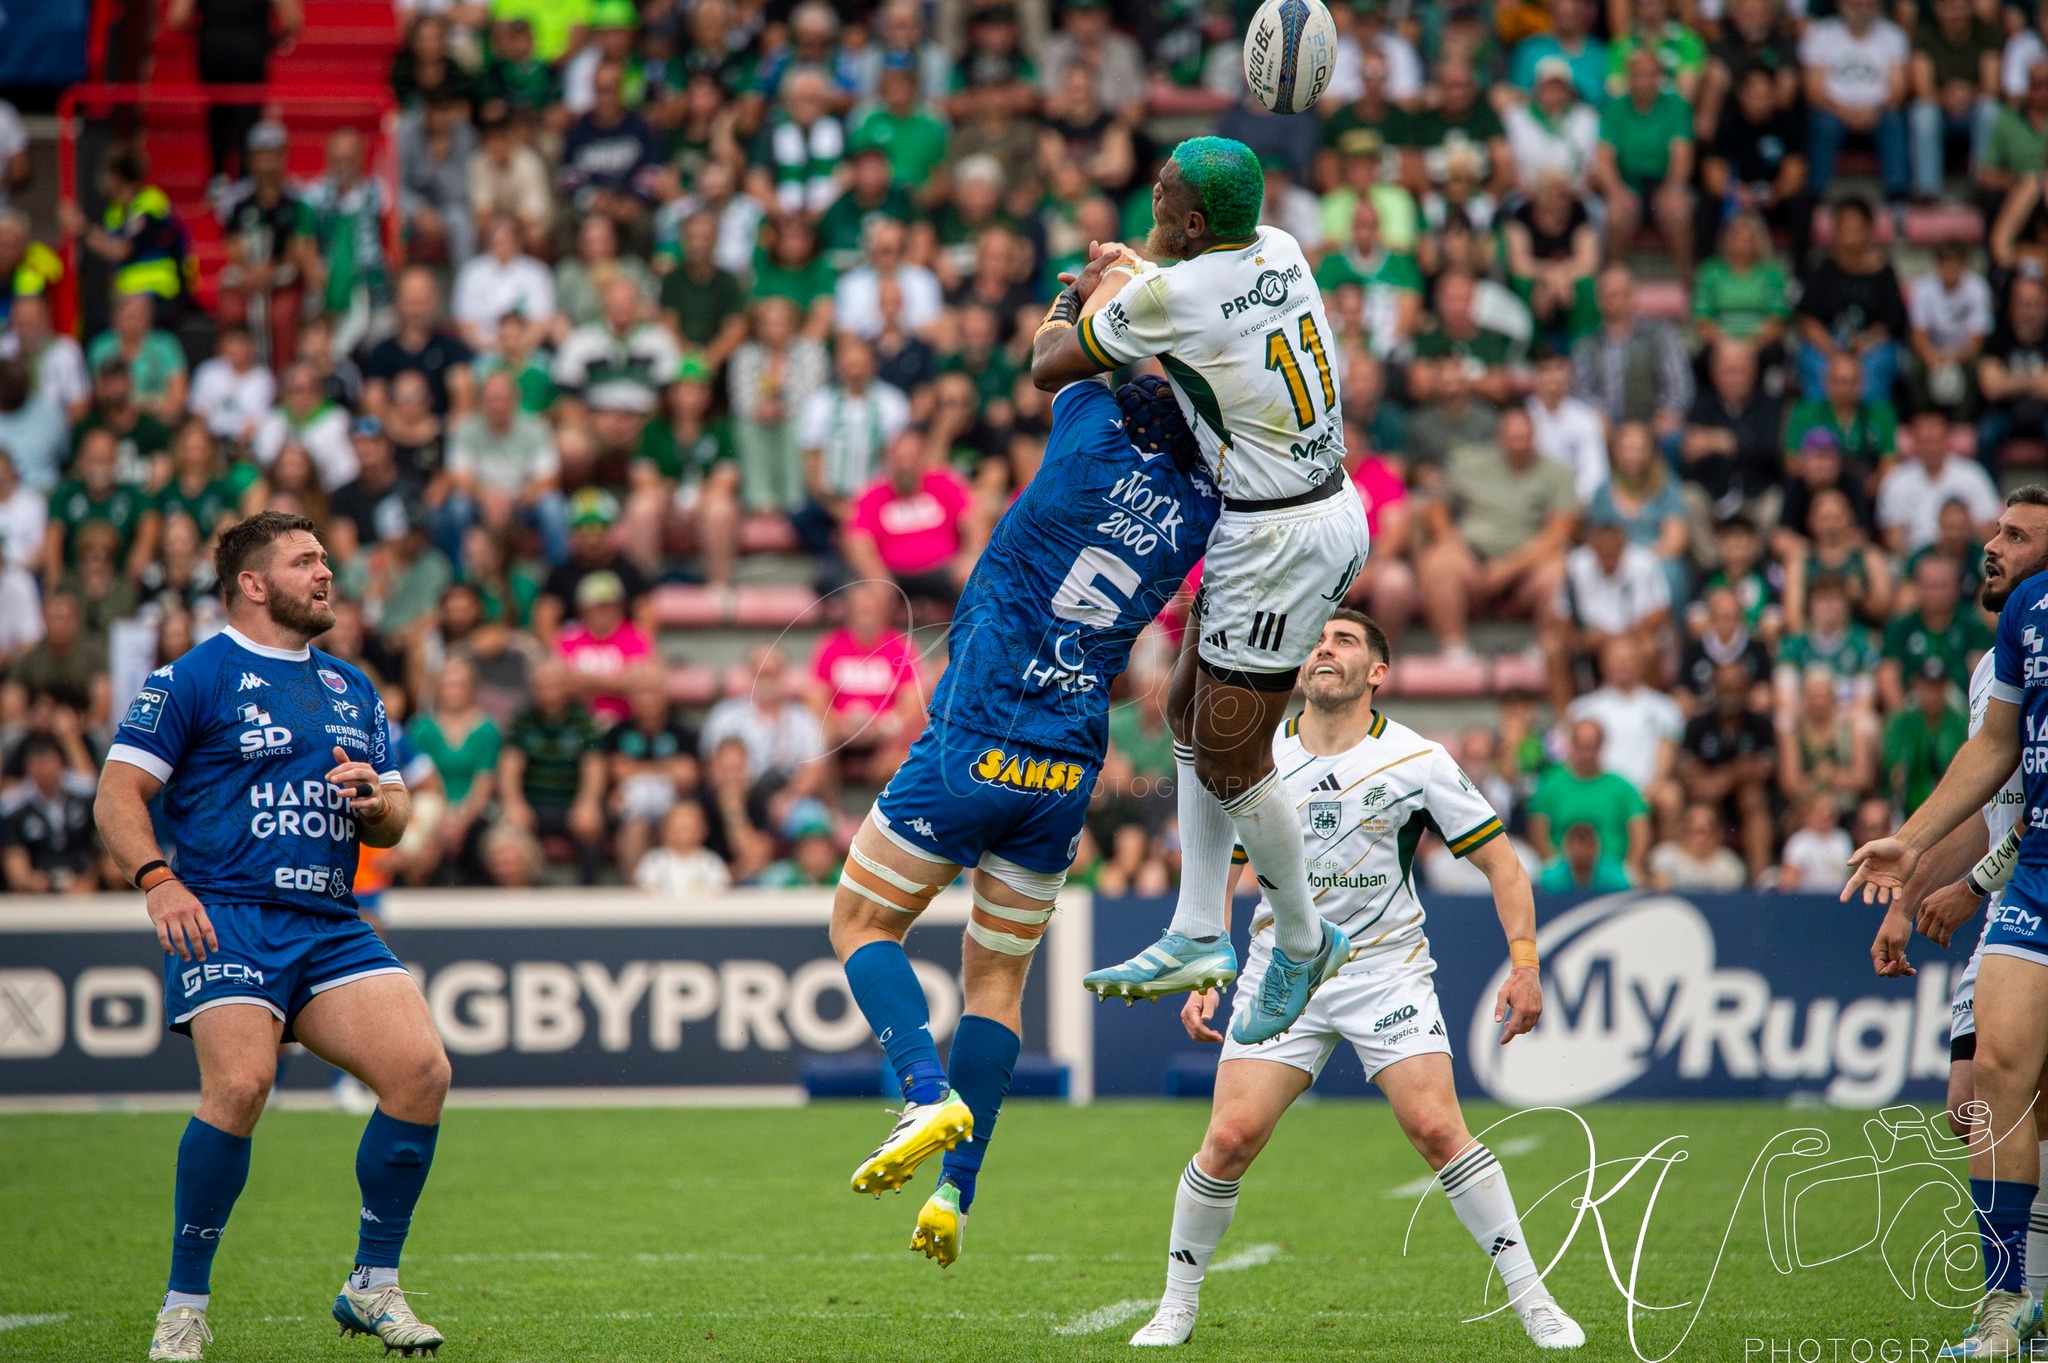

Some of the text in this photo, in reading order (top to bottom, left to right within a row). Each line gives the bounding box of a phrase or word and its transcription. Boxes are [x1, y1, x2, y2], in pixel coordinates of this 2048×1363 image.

[1240, 329, 1250, 338] LE
[1269, 314, 1278, 323] DE
[1265, 311, 1336, 431] 11
[1109, 471, 1184, 553] Work
[1097, 512, 1158, 556] 2000
[1052, 546, 1142, 630] 6
[1022, 658, 1099, 693] HRS
[137, 692, 161, 703] PRO
[128, 708, 154, 726] D2
[240, 726, 292, 753] SD
[324, 724, 363, 741] GRENOBLE
[243, 746, 293, 761] SERVICES
[969, 748, 1085, 797] SAMSE
[251, 810, 356, 843] GROUP
[1325, 859, 1338, 869] de
[275, 867, 330, 892] eos
[2002, 923, 2034, 937] GROUP
[1373, 1004, 1416, 1033] SEKO
